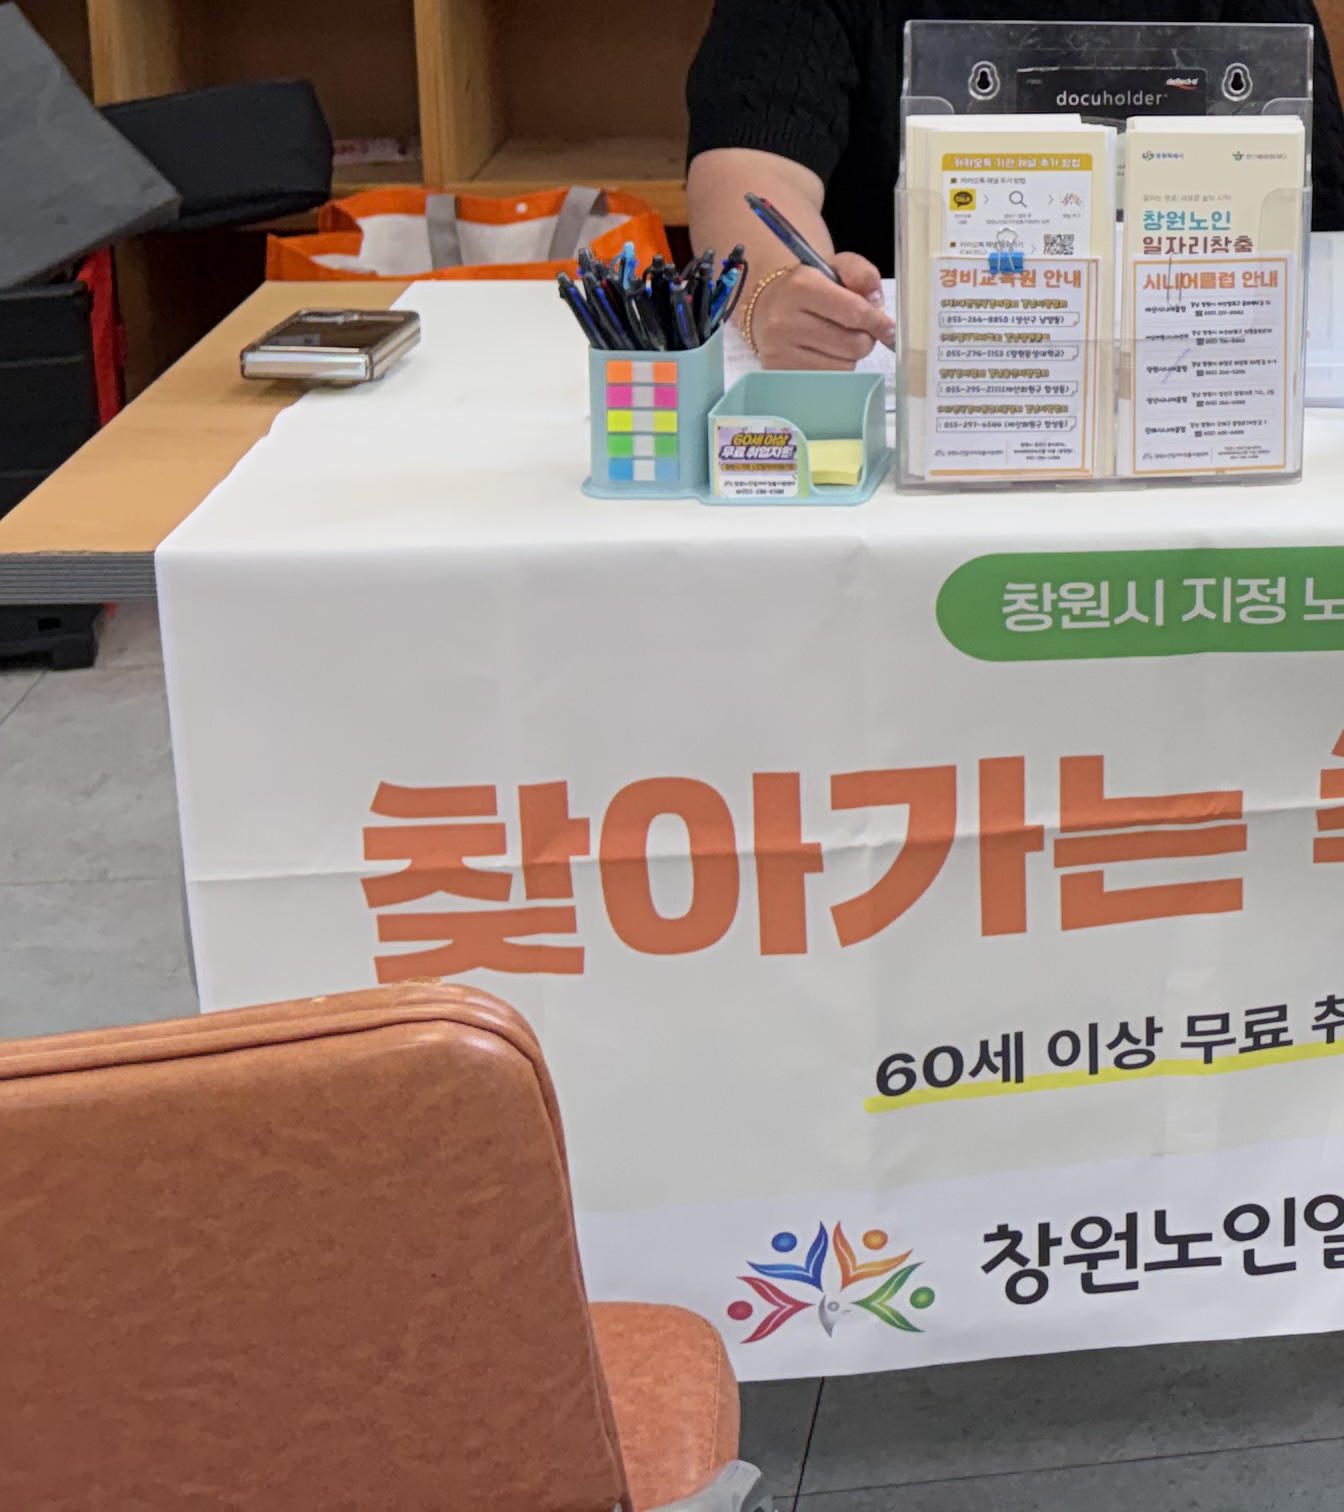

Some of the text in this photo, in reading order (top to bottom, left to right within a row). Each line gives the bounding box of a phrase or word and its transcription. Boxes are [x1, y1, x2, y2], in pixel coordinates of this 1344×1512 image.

[1056, 90, 1162, 107] docuholder
[954, 157, 992, 168] 카카오톡
[1040, 157, 1059, 167] 추가
[1143, 210, 1231, 231] 창원노인
[1143, 235, 1254, 255] 일자리창출
[939, 268, 1082, 288] 경비교육원 안내
[1143, 270, 1278, 290] 시니어클럽 안내
[1001, 579, 1164, 631] 창원시
[1182, 577, 1287, 627] 지정
[360, 754, 1248, 986] 찾아가는
[876, 1031, 1026, 1097] 60세
[1047, 1015, 1164, 1076] 이상
[1180, 1002, 1293, 1065] 무료
